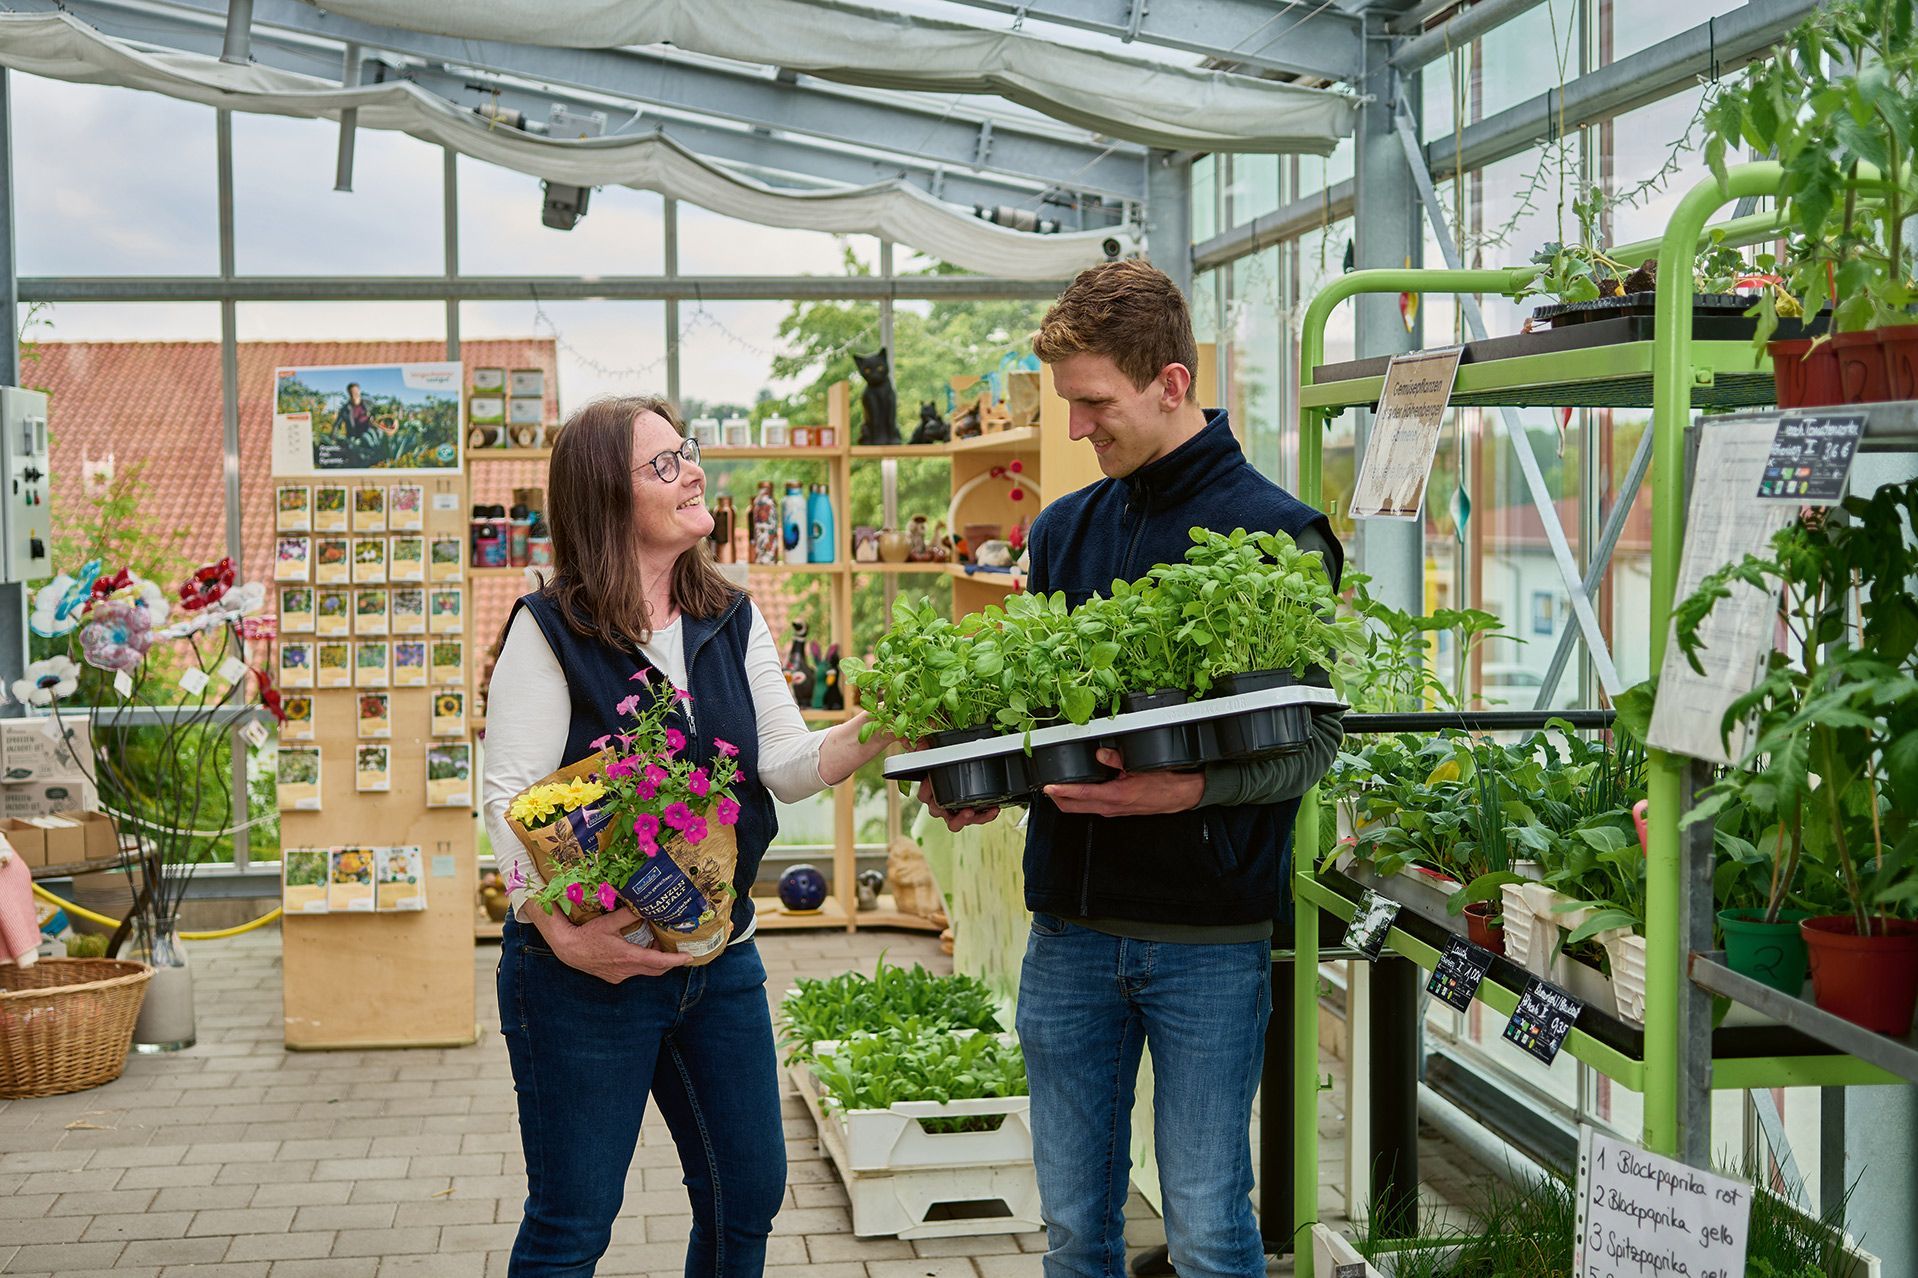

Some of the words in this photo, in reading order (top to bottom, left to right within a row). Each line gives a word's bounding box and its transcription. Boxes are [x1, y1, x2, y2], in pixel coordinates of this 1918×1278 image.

[1393, 378, 1443, 397] Gemüsepflanzen
[1597, 1147, 1606, 1171] 1
[1617, 1150, 1707, 1196] Blockpaprika
[1715, 1188, 1743, 1206] rot
[1593, 1184, 1605, 1207] 2
[1608, 1188, 1692, 1232] Blockpaprika
[1699, 1224, 1734, 1248] gelb
[1589, 1222, 1603, 1251] 3
[1606, 1230, 1691, 1278] Spitzpaprika
